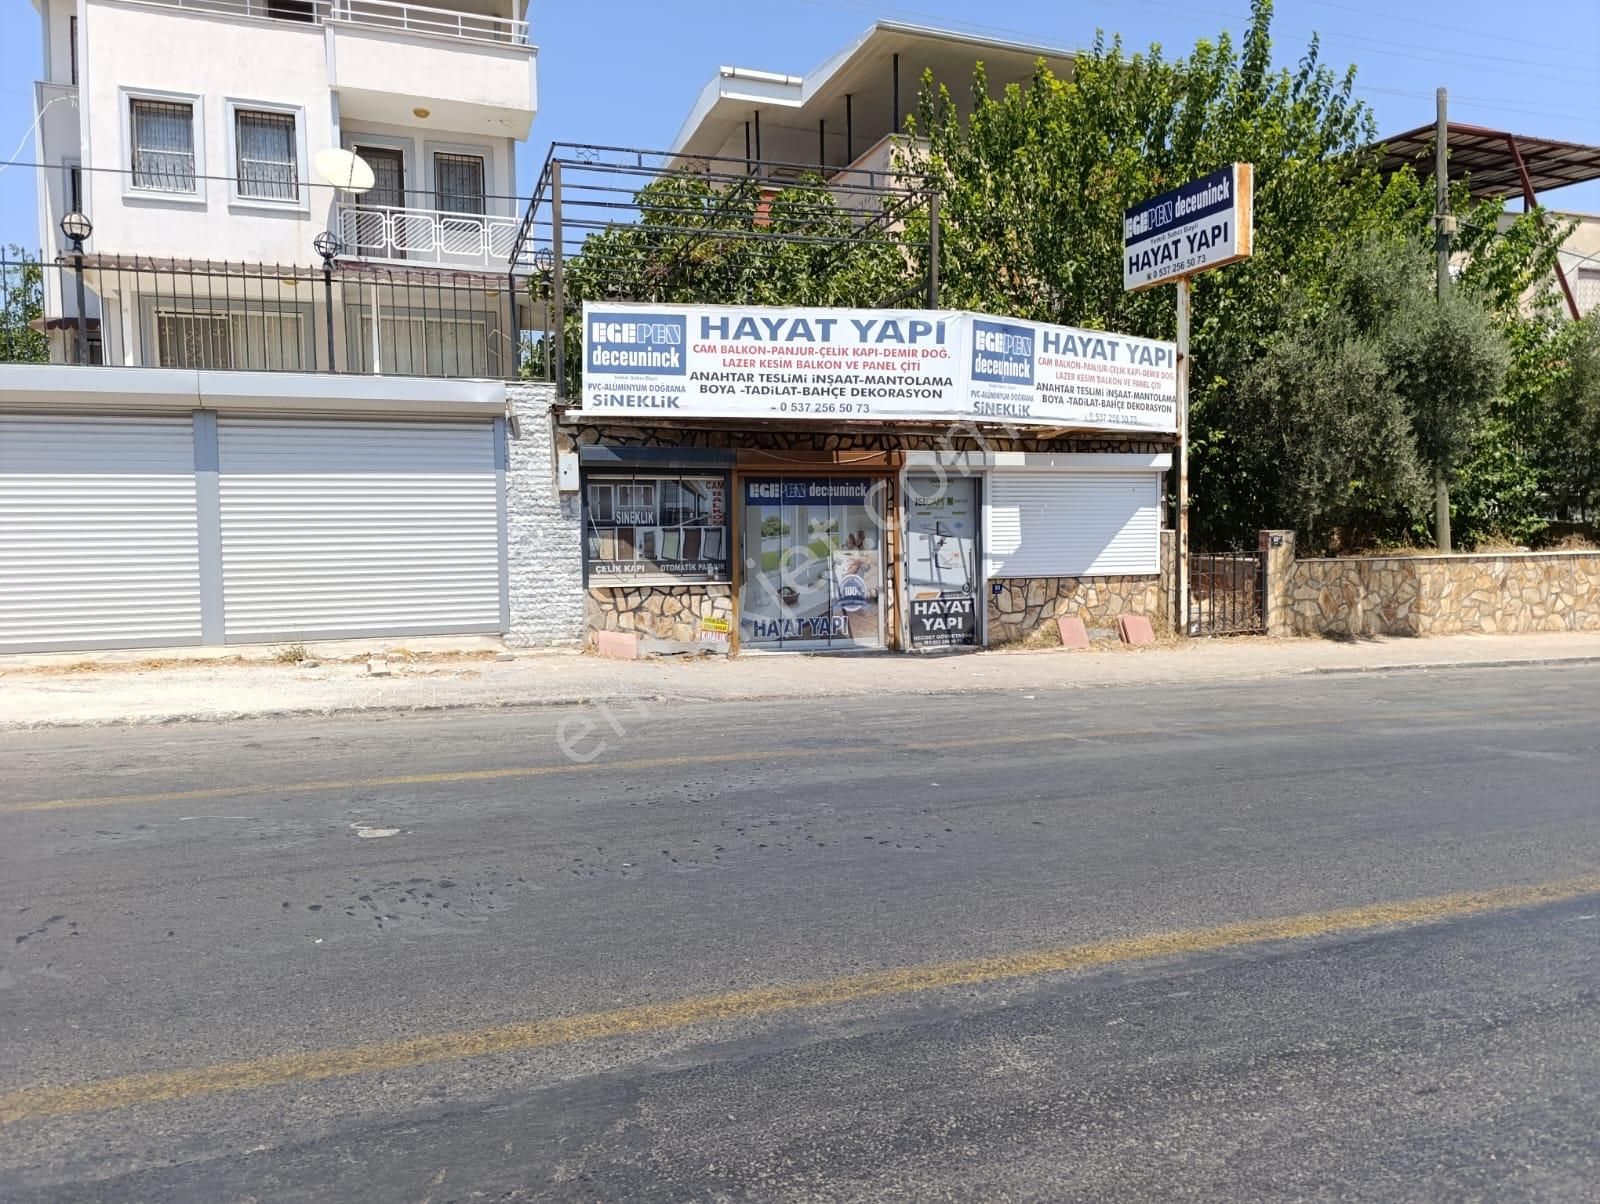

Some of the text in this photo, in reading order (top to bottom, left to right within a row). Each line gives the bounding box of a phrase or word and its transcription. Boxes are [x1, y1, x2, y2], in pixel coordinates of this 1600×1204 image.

[1125, 176, 1230, 239] EGEPEN deceuninck
[1129, 221, 1228, 275] HAYAT YAPI
[1153, 254, 1206, 279] 0 537 256 50 73
[592, 322, 681, 344] EGEPEN
[700, 316, 946, 345] HAYAT YAPI
[693, 344, 717, 354] CAM
[852, 347, 918, 358] KAPI-DEMİR
[921, 348, 951, 359] DOĞ.
[975, 329, 1032, 357] EGEPEN
[1043, 331, 1173, 369] HAYAT YAPI
[592, 345, 680, 368] deceuninck
[1038, 356, 1053, 367] CAM
[723, 359, 921, 373] LAZER KESİM BALKON VE PANEL ÇİTİ
[975, 355, 1031, 379] deceuninck
[689, 371, 755, 383] ANAHTAR
[1056, 371, 1076, 381] LAZER
[1097, 375, 1123, 386] BALKON
[1124, 378, 1131, 387] VE
[1132, 379, 1150, 389] PANEL
[700, 384, 736, 394] BOYA
[850, 387, 943, 399] DEKORASYON
[1036, 382, 1075, 395] ANAHTAR
[780, 402, 870, 414] 0 537 256 50 73
[1042, 394, 1065, 405] BOYA
[1127, 401, 1172, 414] DEKORASYON
[1095, 412, 1107, 422] 537
[749, 482, 867, 498] EGEPEN deceuninck
[624, 564, 645, 573] KAPI
[914, 601, 972, 616] HAYAT
[753, 616, 849, 637] HAYAT YAPI
[921, 618, 963, 631] YAPI
